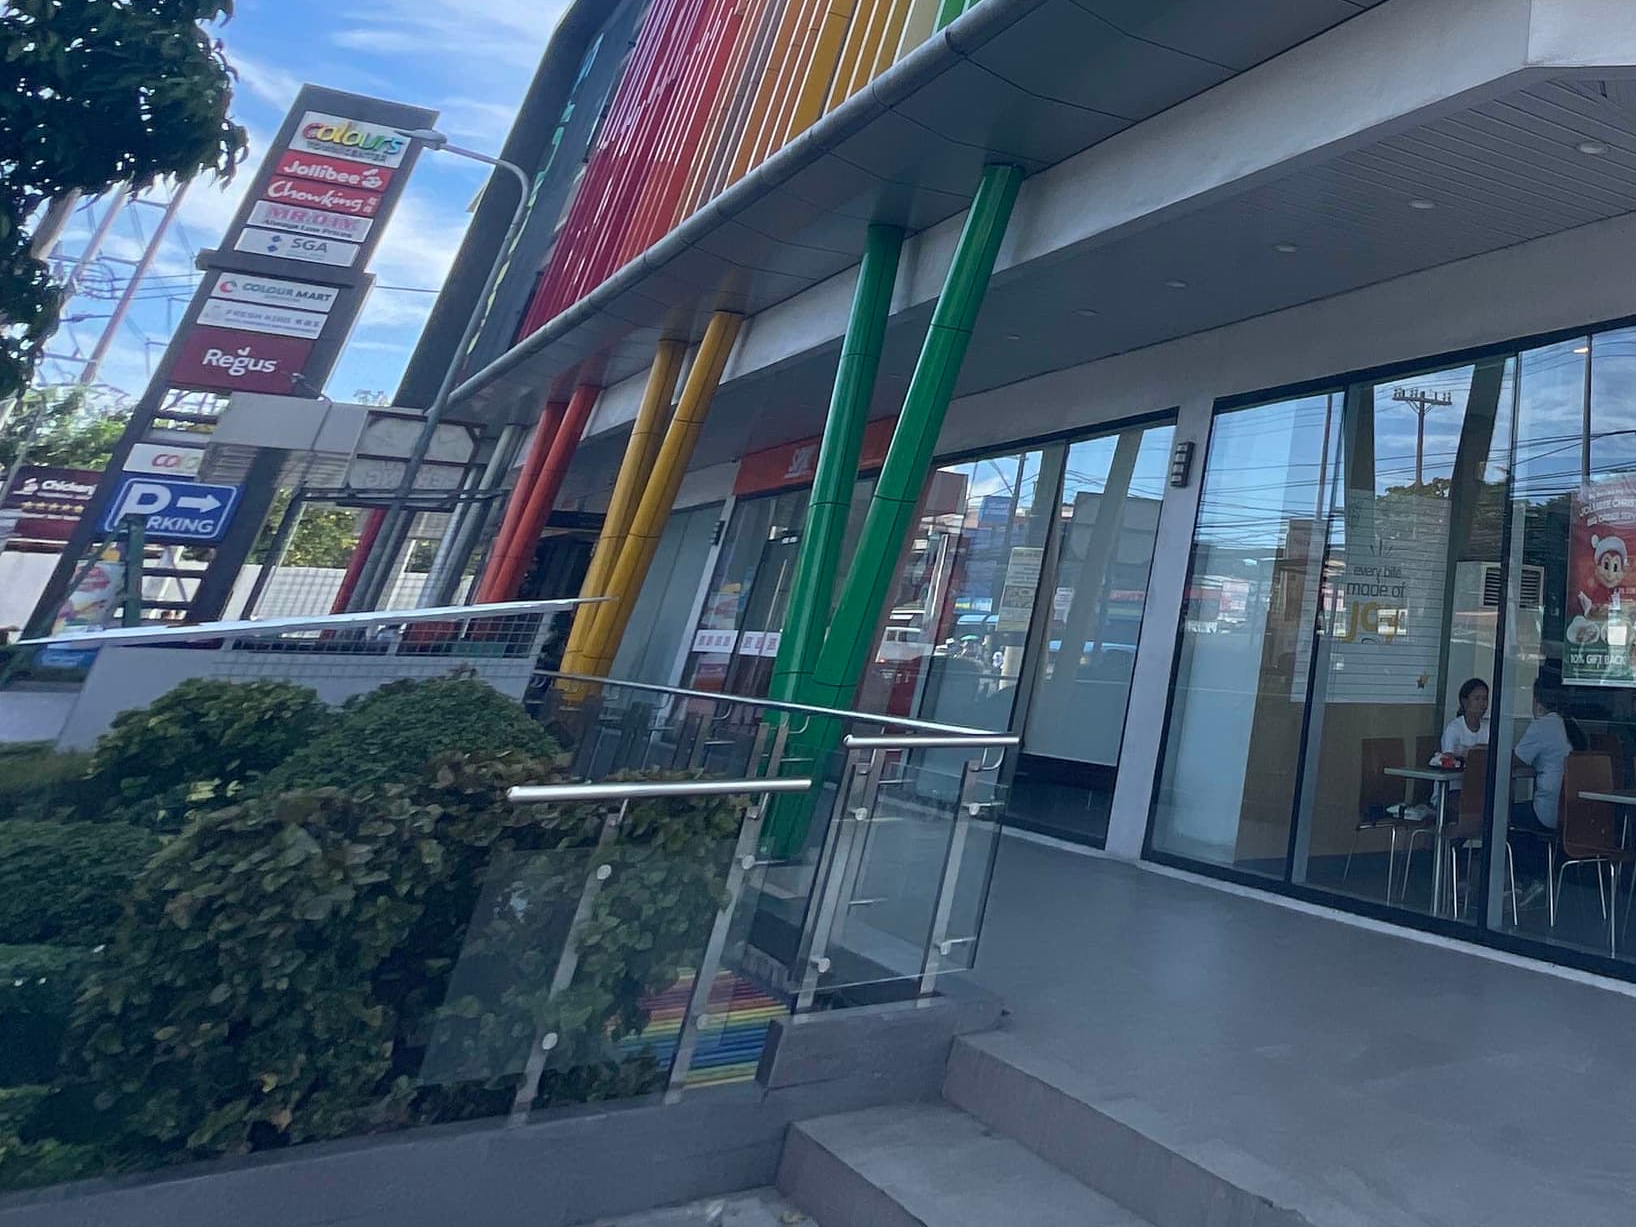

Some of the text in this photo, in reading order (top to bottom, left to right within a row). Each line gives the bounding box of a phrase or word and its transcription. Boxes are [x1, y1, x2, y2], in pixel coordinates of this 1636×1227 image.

[283, 160, 360, 185] Jollibee
[268, 180, 364, 212] Chowking
[291, 238, 328, 254] SGA
[242, 282, 294, 298] COLOUR
[295, 290, 332, 302] MART
[202, 347, 277, 376] Regus
[140, 516, 215, 533] RKING
[1346, 580, 1407, 598] made of
[1585, 654, 1603, 665] GIFT
